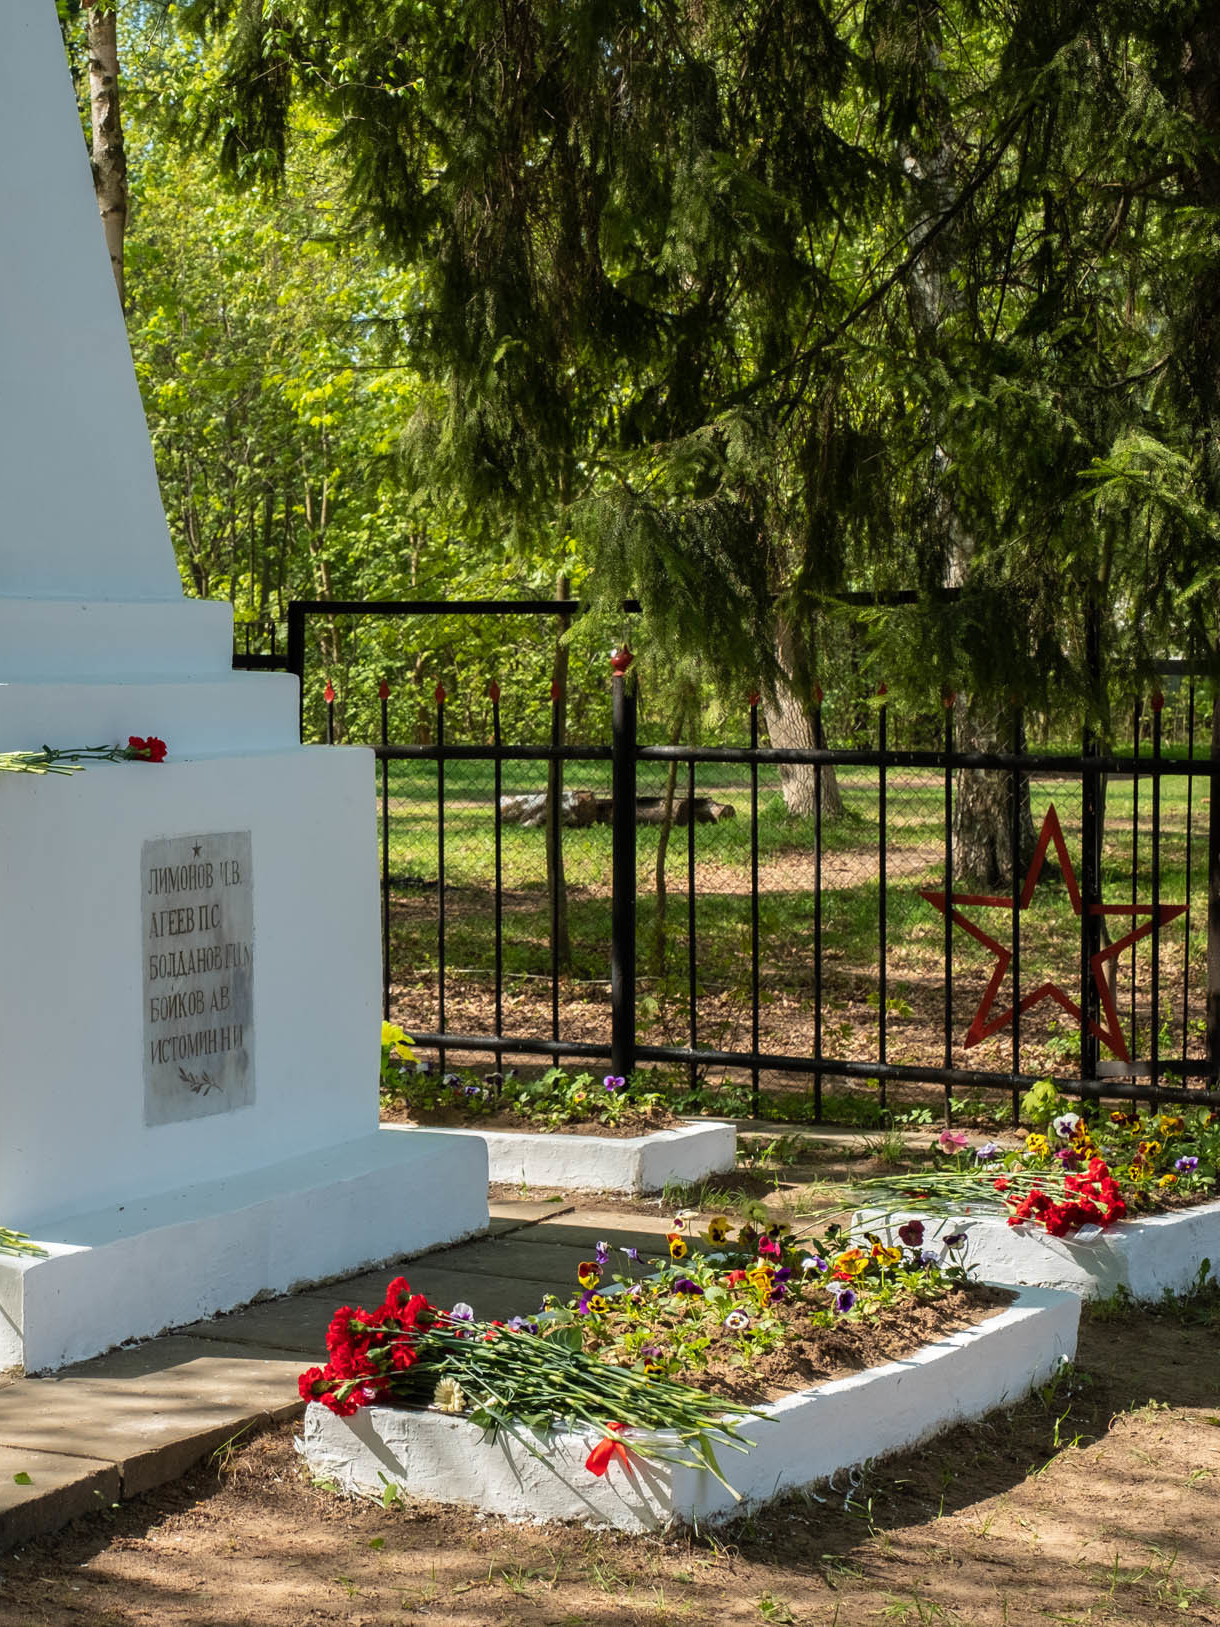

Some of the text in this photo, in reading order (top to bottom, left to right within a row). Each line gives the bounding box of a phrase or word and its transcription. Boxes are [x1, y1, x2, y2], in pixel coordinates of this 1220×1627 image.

[147, 863, 214, 895] ЛИМОНОВ
[149, 906, 196, 939] АГЕЕВ
[150, 1027, 218, 1065] ИСТОМИН
